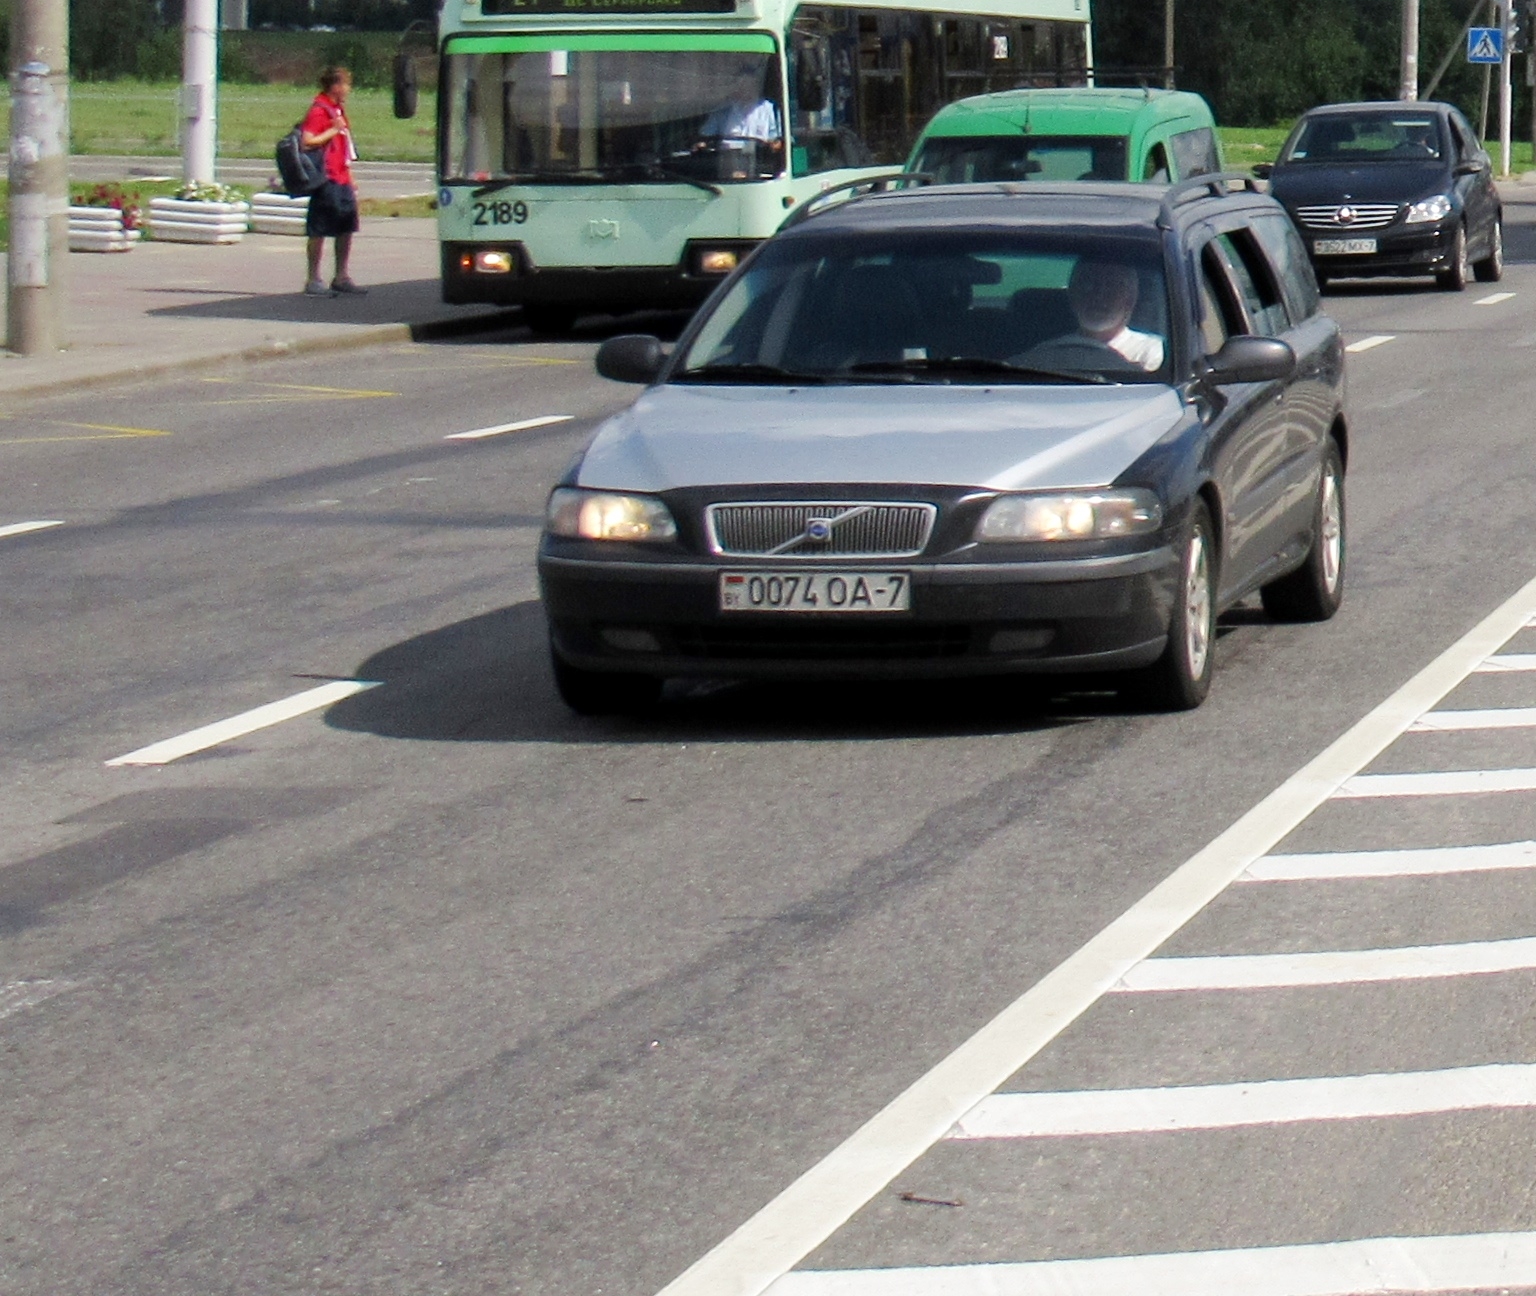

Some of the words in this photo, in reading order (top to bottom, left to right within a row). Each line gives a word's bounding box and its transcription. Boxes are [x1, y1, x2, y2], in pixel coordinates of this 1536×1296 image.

[473, 200, 528, 226] 2189
[749, 576, 818, 606] 0074
[828, 576, 905, 607] OA-7
